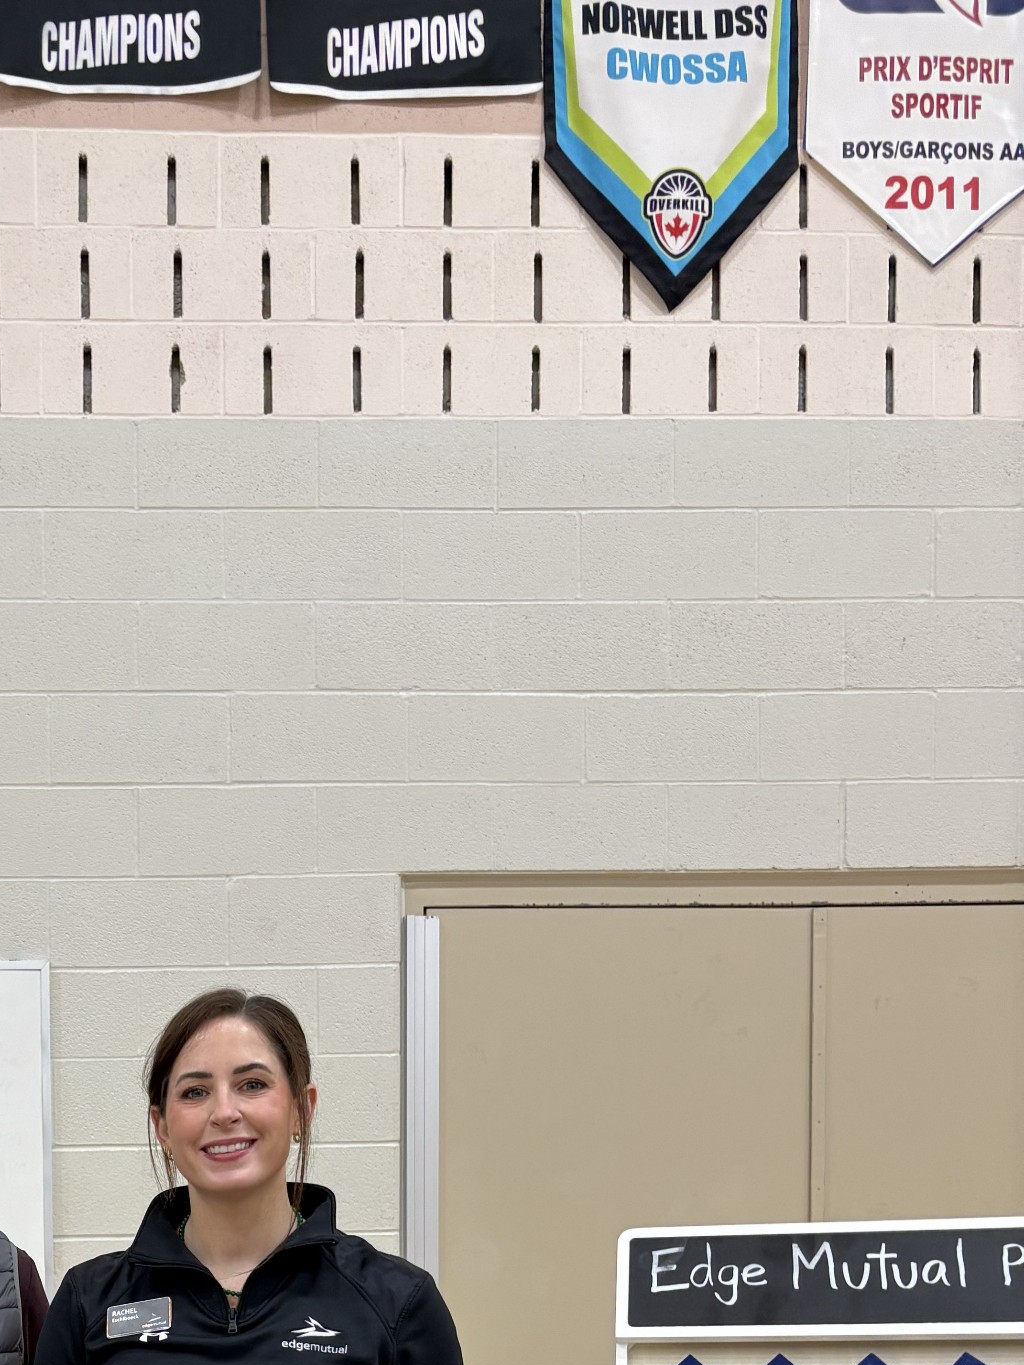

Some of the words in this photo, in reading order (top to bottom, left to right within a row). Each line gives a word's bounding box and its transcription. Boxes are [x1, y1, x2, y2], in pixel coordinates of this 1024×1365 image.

[581, 1, 708, 41] NORWELL
[714, 4, 768, 39] DSS
[41, 9, 202, 72] CHAMPIONS
[326, 8, 486, 78] CHAMPIONS
[606, 47, 748, 85] CWOSSA
[859, 55, 912, 83] PRIX
[890, 92, 982, 120] SPORTIF
[842, 140, 994, 164] BOYS/GARÇONS
[649, 198, 706, 214] OVERKILL
[884, 175, 980, 211] 2011
[650, 1241, 768, 1306] Edge
[791, 1237, 967, 1291] Mutual
[112, 1307, 138, 1317] RACHEL
[281, 1338, 349, 1355] edgemutual
